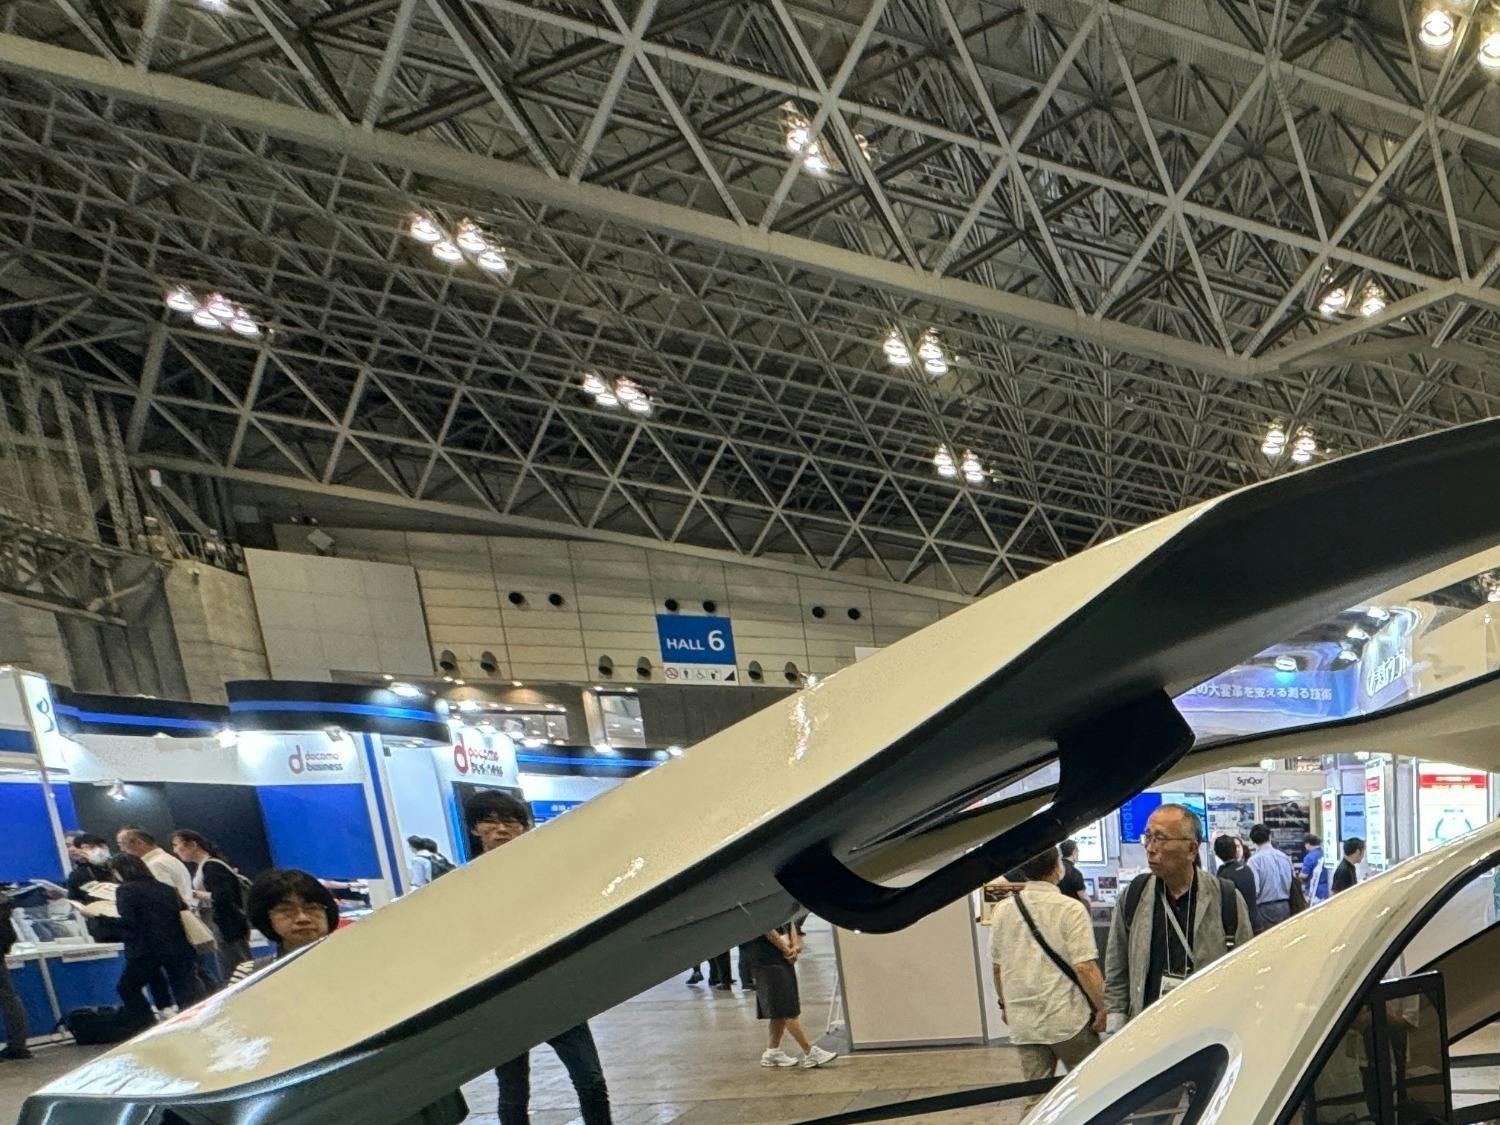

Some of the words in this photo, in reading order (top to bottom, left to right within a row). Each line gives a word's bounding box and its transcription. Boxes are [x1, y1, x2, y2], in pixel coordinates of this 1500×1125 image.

[666, 638, 705, 650] HALL
[708, 630, 725, 651] 6
[1236, 775, 1263, 786] SynQor
